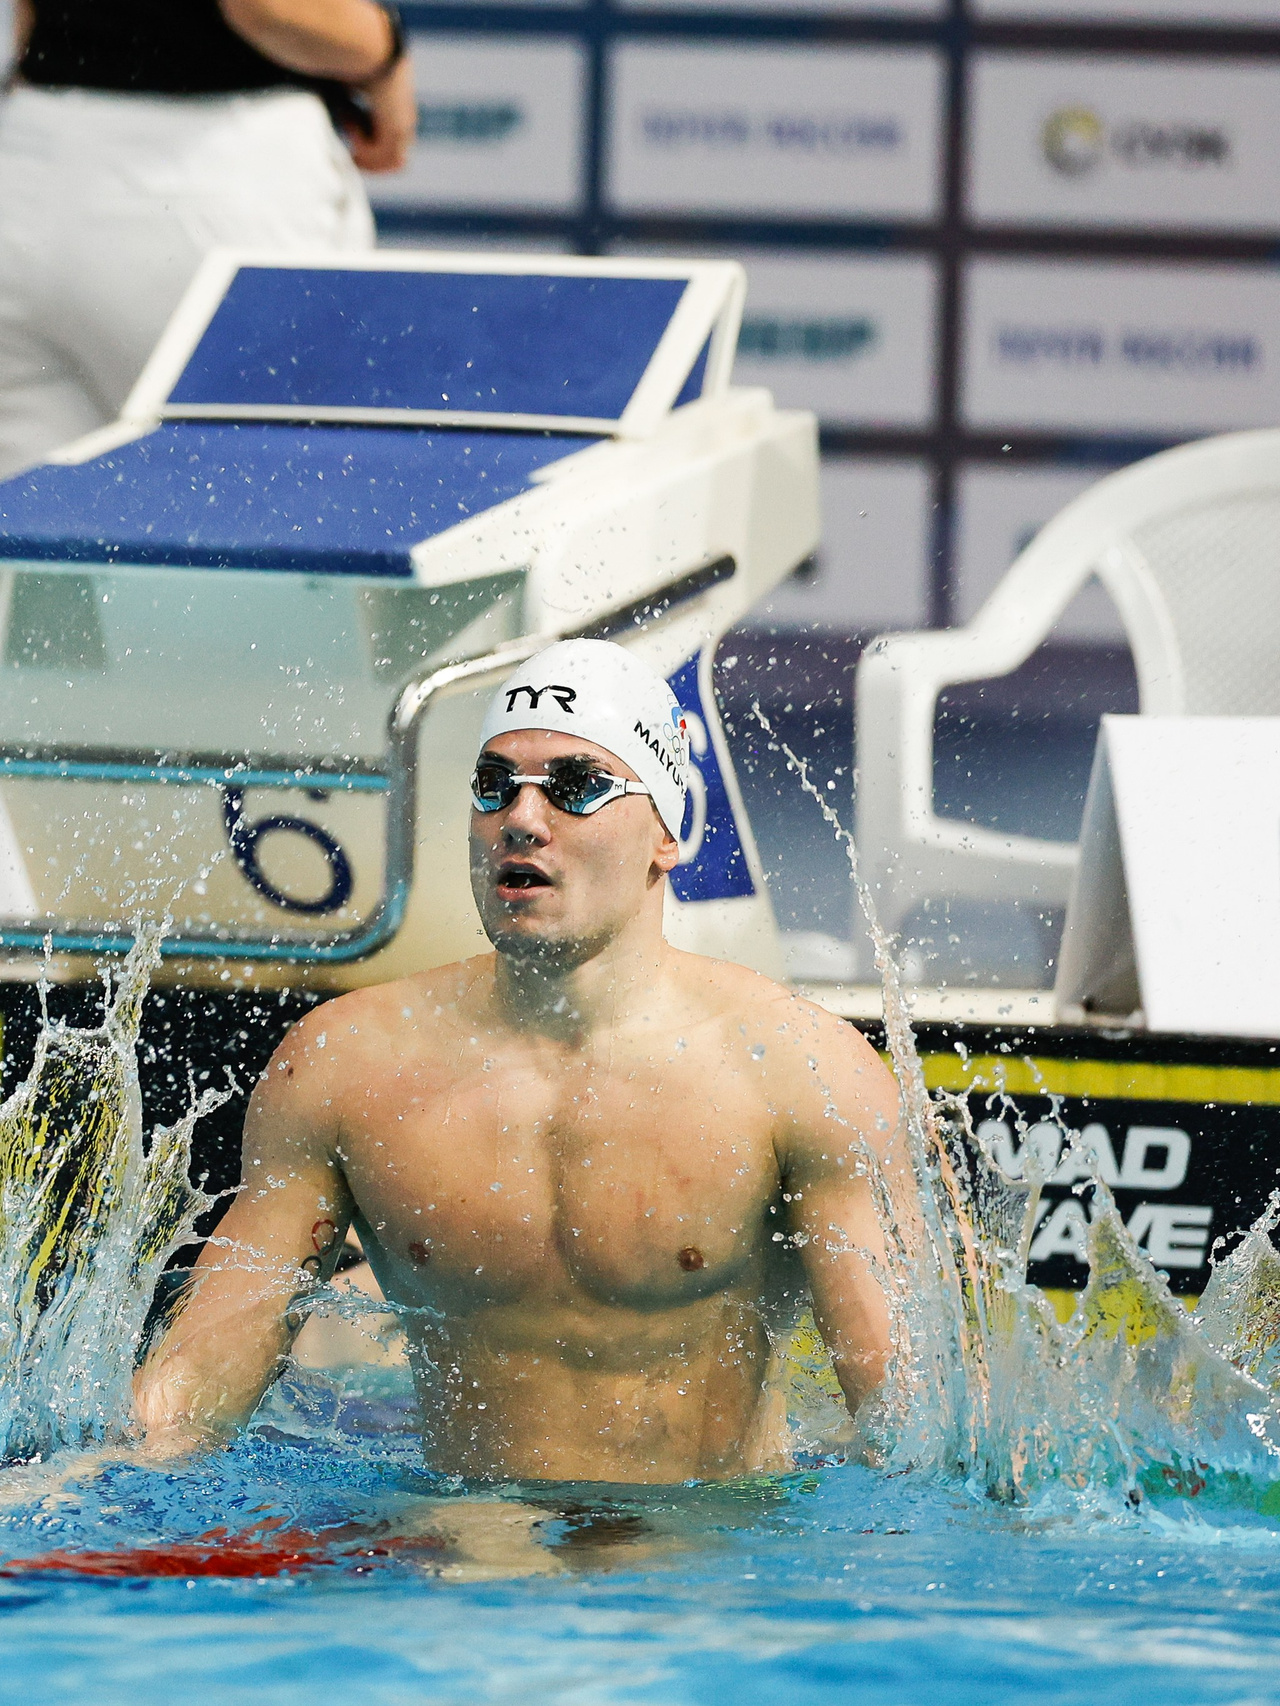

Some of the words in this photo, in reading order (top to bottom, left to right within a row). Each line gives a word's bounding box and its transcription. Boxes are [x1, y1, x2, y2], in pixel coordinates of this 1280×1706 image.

[505, 684, 577, 714] TYR
[221, 782, 353, 917] 6
[1025, 1198, 1214, 1270] AE
